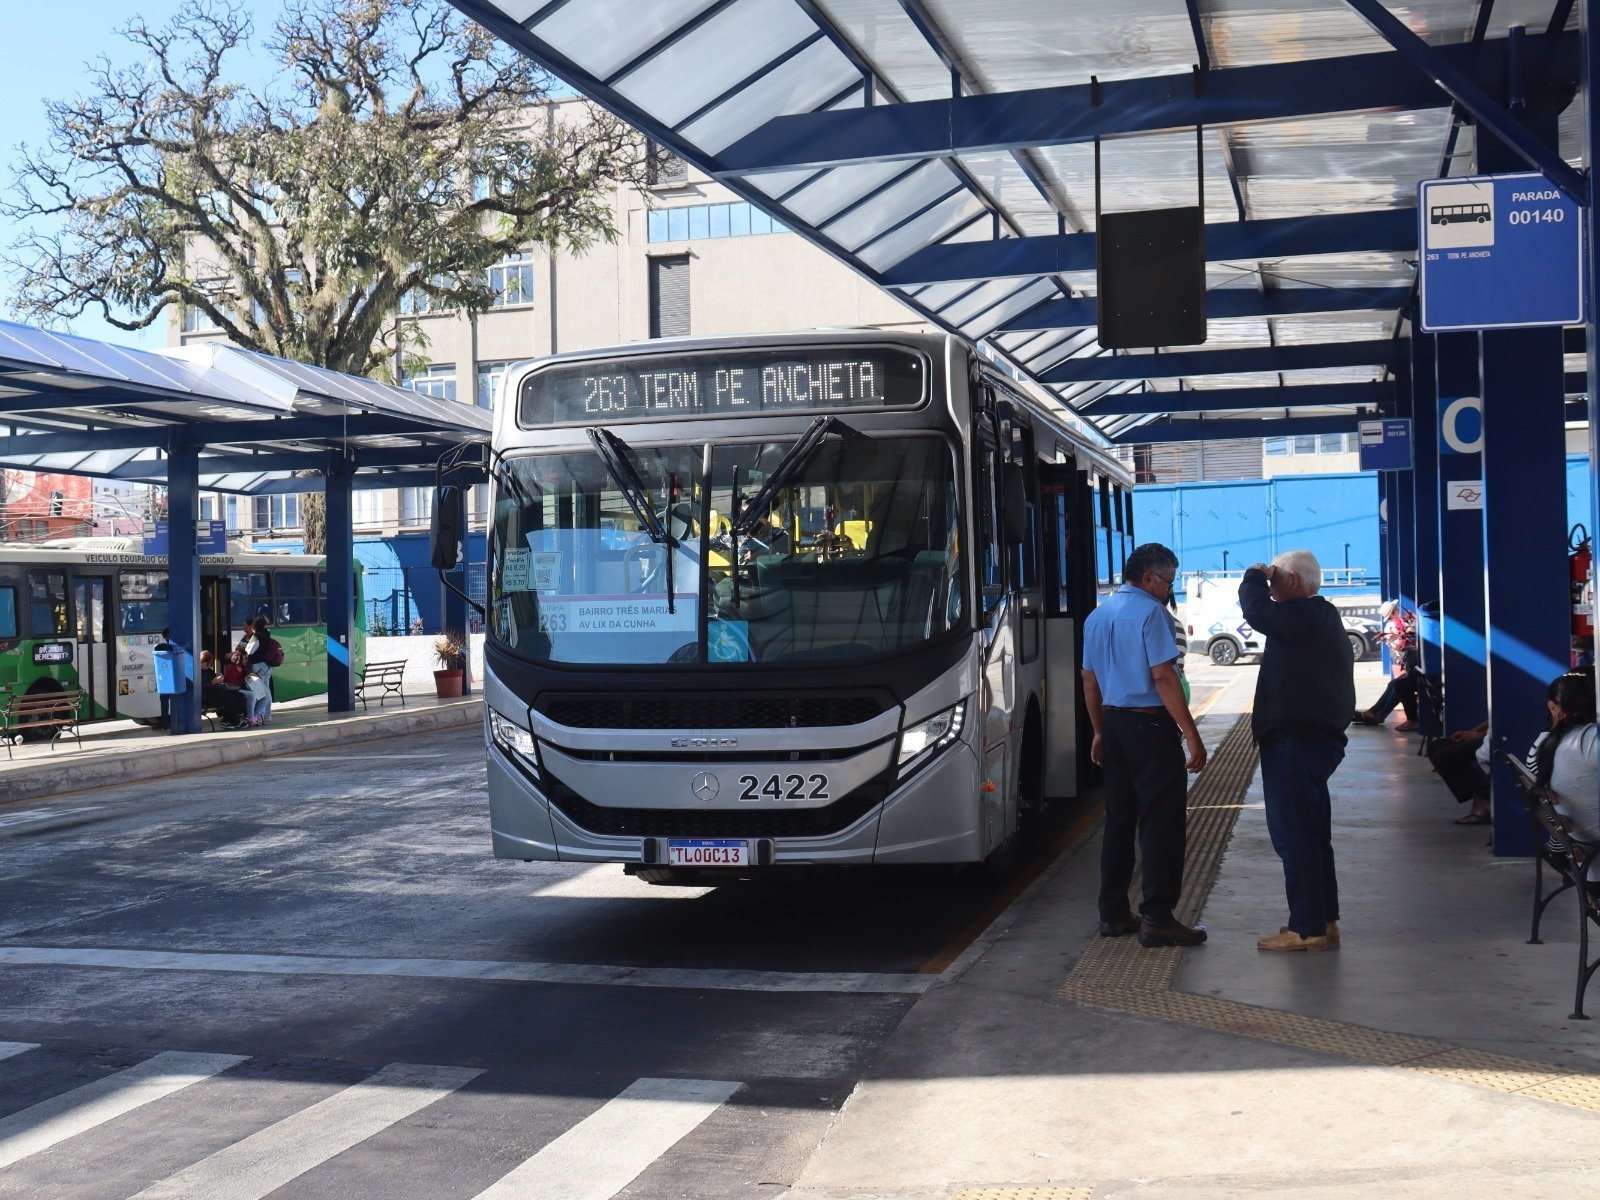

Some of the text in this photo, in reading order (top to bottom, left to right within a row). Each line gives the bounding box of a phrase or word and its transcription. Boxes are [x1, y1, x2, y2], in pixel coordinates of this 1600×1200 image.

[1512, 190, 1561, 202] PARADA
[1509, 208, 1564, 226] 00140
[1426, 253, 1440, 261] 263
[583, 376, 627, 412] 263
[639, 371, 703, 409] TERM.
[715, 369, 750, 405] PE.
[85, 554, 234, 564] VEICULO EQUIPADO CO DICIONADO
[542, 604, 564, 612] LINHA
[579, 607, 613, 616] BAIRRO
[615, 605, 639, 615] TRÊS
[540, 613, 567, 632] 263
[579, 619, 656, 629] AV LIX DA CUNHA
[738, 774, 830, 801] 2422
